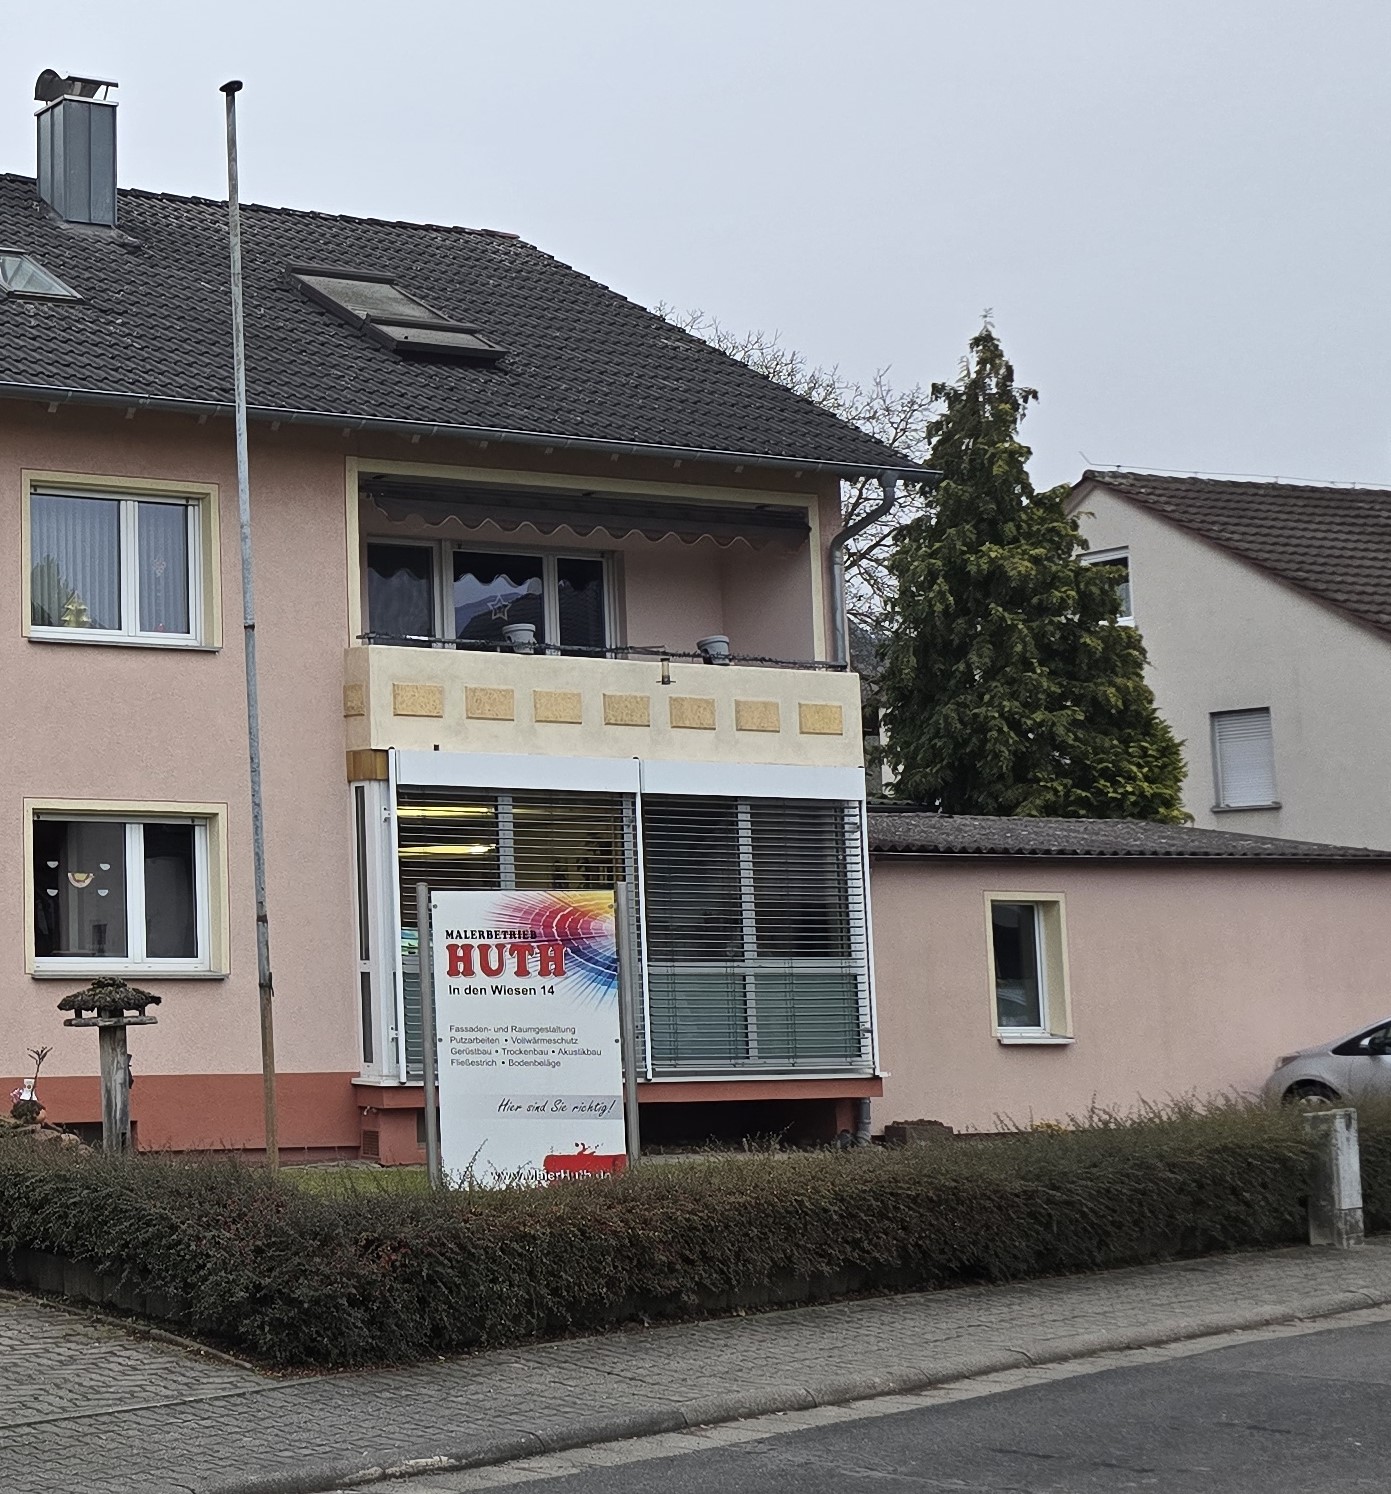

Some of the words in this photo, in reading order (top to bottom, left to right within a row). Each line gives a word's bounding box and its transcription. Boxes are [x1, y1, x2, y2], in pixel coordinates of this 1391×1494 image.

[445, 929, 537, 940] MALERBETRIEB
[446, 943, 567, 978] HUTH
[449, 985, 460, 996] In
[464, 985, 487, 996] den
[491, 985, 536, 996] Wiesen
[541, 985, 555, 996] 14
[449, 1025, 491, 1033] Fassaden-
[494, 1025, 509, 1033] und
[511, 1025, 576, 1035] Raumgestaltung
[449, 1036, 500, 1044] Putzarbeiten
[511, 1036, 579, 1045] Vollwärmeschutz
[450, 1047, 492, 1056] Gerüstbau
[501, 1047, 549, 1056] Trockenbau
[557, 1047, 602, 1056] Akustikbau
[451, 1058, 497, 1067] Fließestrich
[508, 1058, 561, 1068] Bodenbeläge
[497, 1097, 522, 1112] Hier
[526, 1099, 549, 1113] sind
[550, 1098, 568, 1113] Sie
[571, 1099, 616, 1117] richtig!
